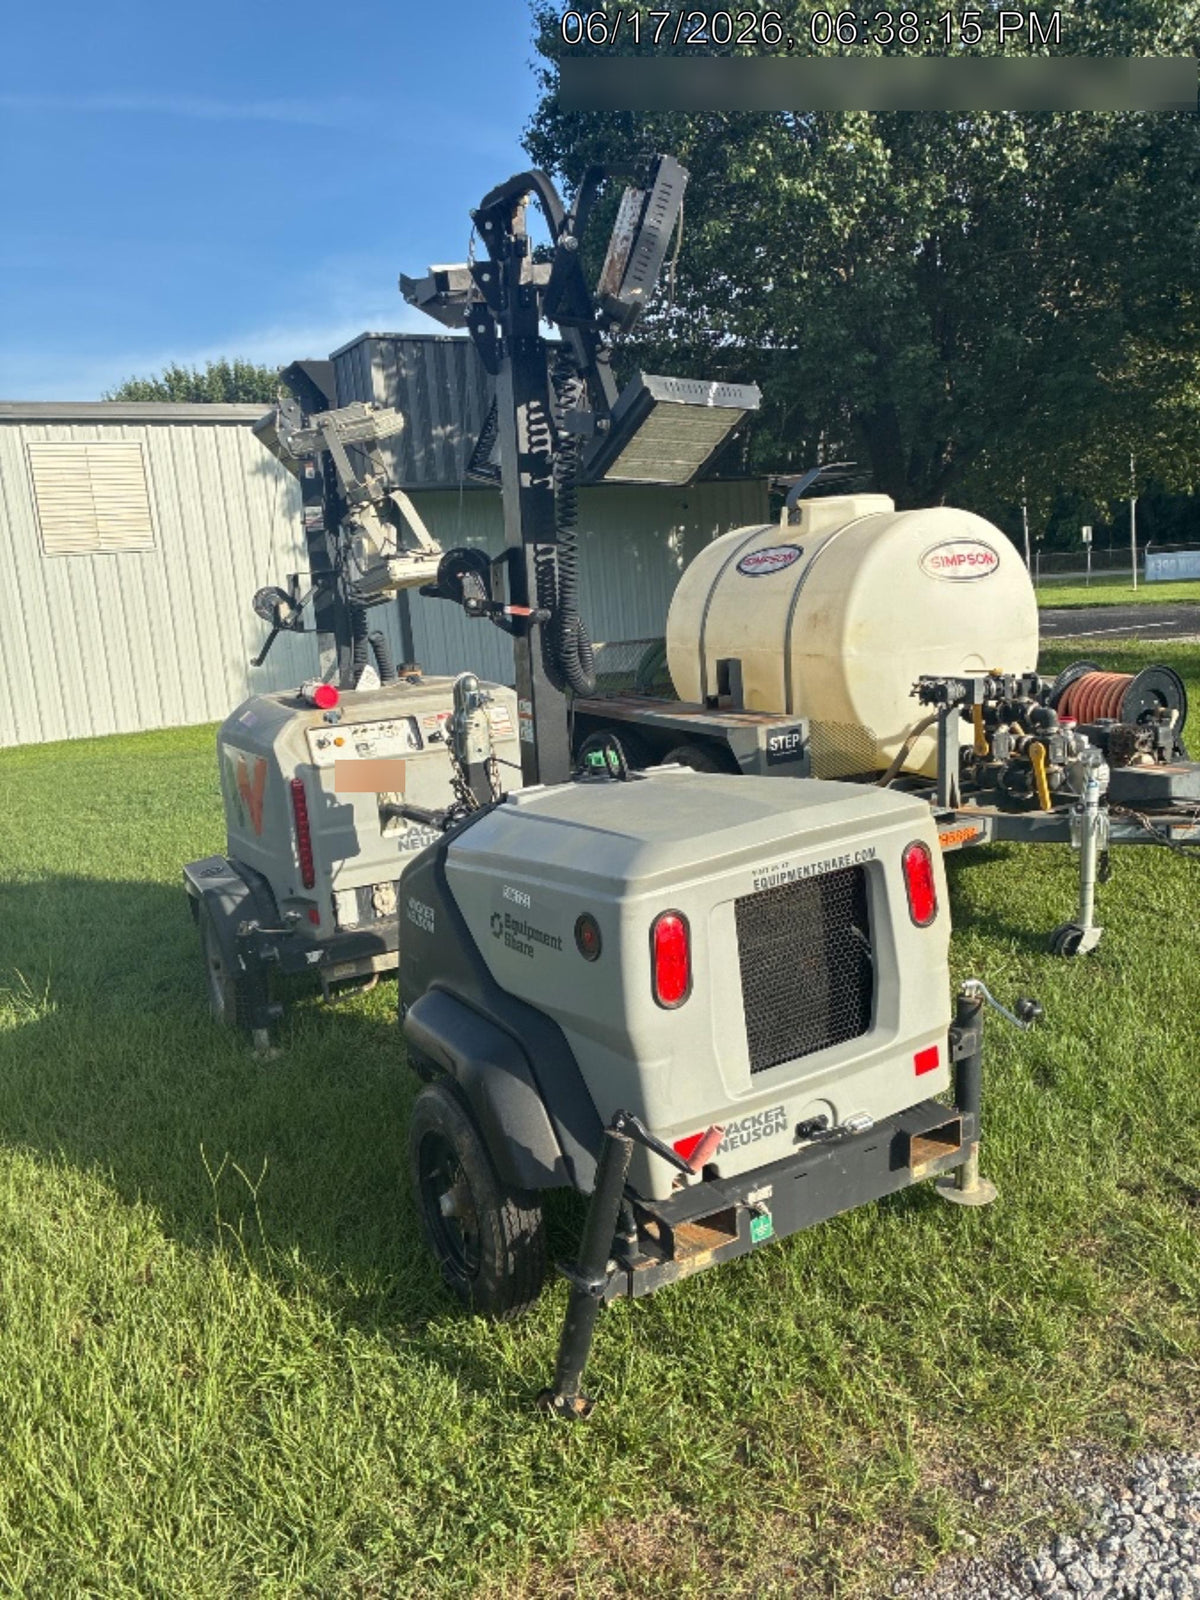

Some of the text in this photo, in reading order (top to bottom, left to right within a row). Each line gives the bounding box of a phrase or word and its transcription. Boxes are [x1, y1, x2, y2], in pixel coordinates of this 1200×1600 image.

[744, 551, 795, 567] SIMPSON
[931, 552, 996, 569] SIMPSON
[770, 734, 799, 751] STEP
[753, 847, 876, 891] EQUIPMENTSHARE.COM
[504, 912, 563, 952] Equipment
[504, 931, 534, 959] Share
[723, 1105, 786, 1138] ACKER
[717, 1118, 788, 1156] NEUSON
